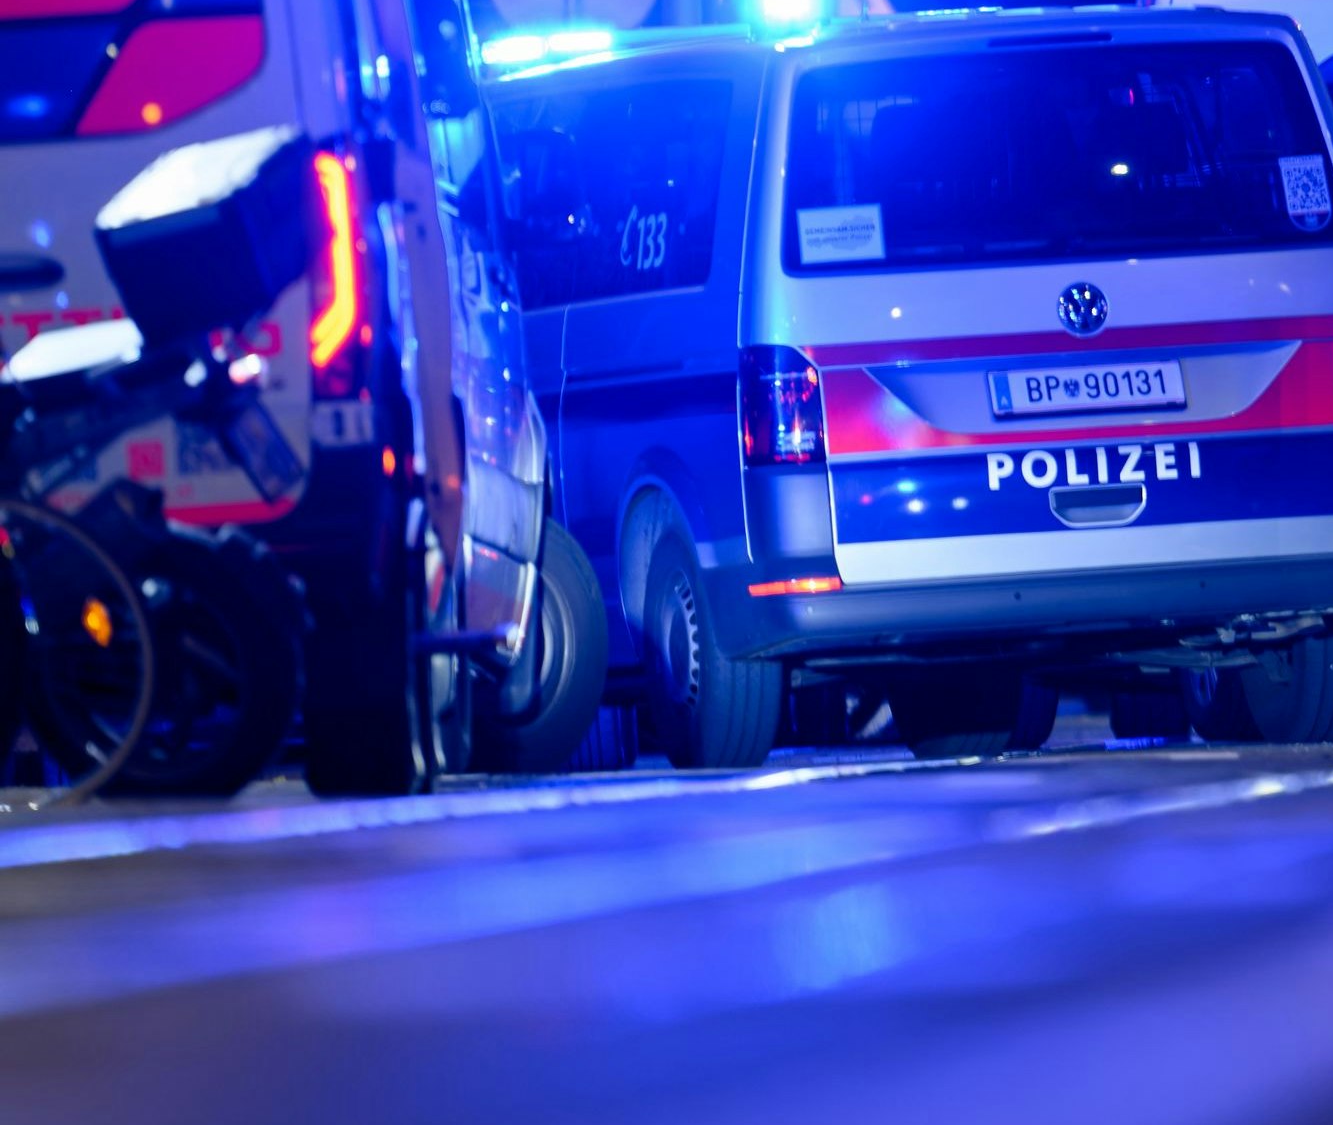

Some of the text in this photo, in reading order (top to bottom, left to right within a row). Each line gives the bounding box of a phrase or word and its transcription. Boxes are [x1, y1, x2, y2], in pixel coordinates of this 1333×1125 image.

[637, 212, 667, 271] 133
[1025, 368, 1167, 403] BP 90131
[986, 441, 1201, 491] POLIZEI
